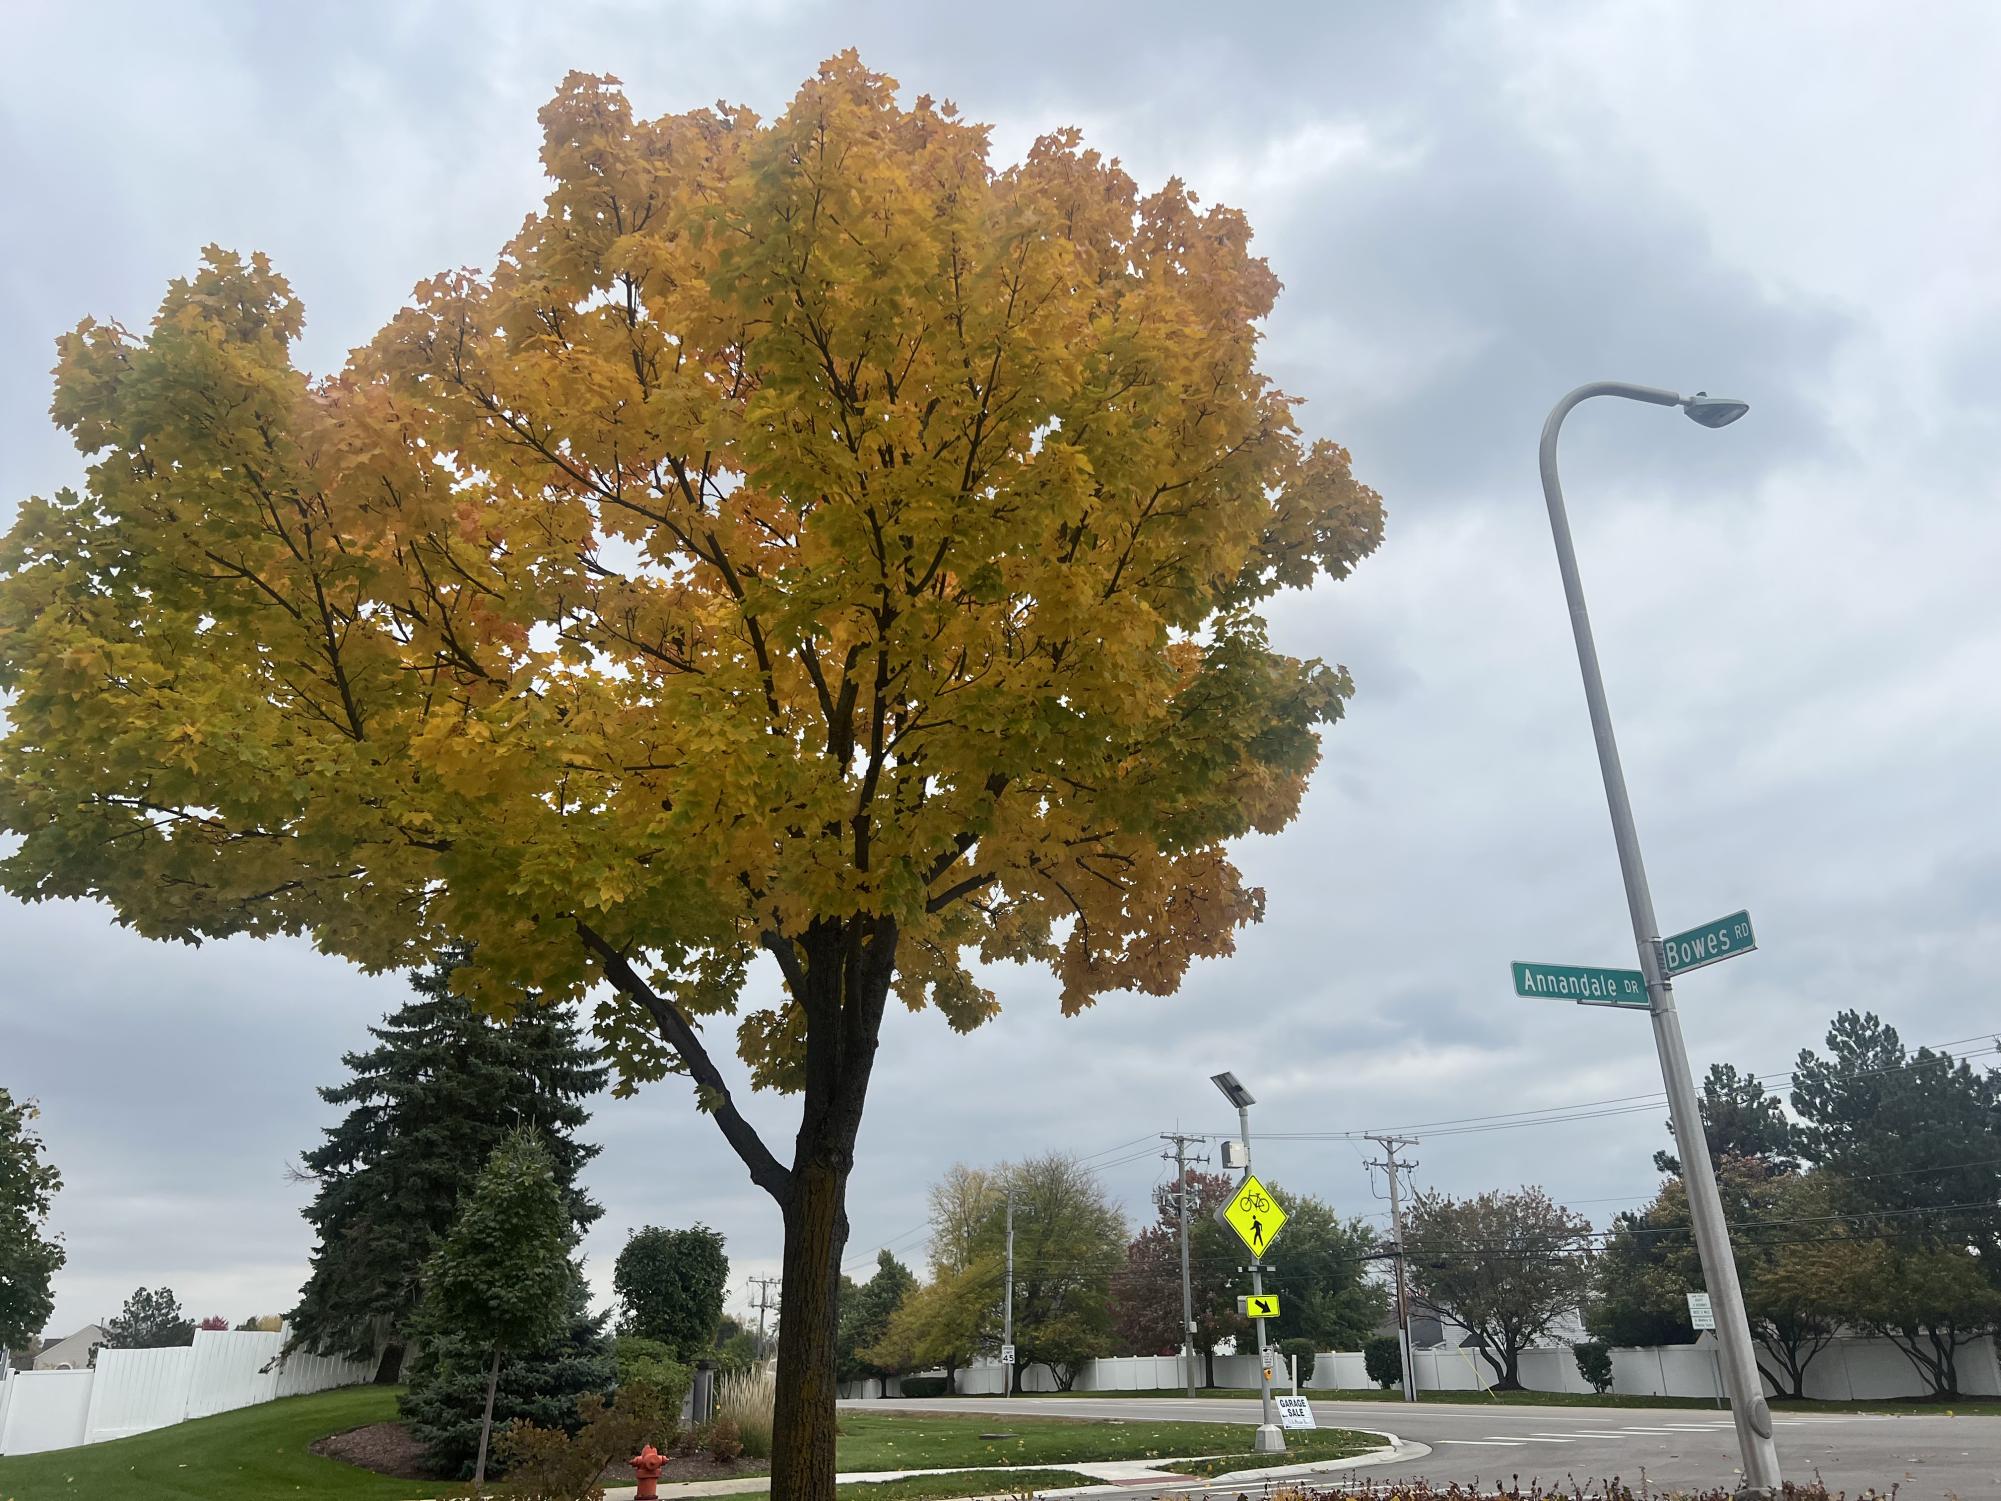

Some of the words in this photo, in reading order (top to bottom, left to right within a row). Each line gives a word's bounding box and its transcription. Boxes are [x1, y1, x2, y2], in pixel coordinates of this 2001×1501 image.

[1665, 929, 1730, 968] Bowes
[1734, 922, 1749, 940] RD
[1524, 968, 1617, 996] Annandale
[1623, 979, 1639, 993] DR
[1003, 1354, 1014, 1362] 45
[1279, 1399, 1307, 1408] GARAGE
[1287, 1408, 1305, 1417] SALE
